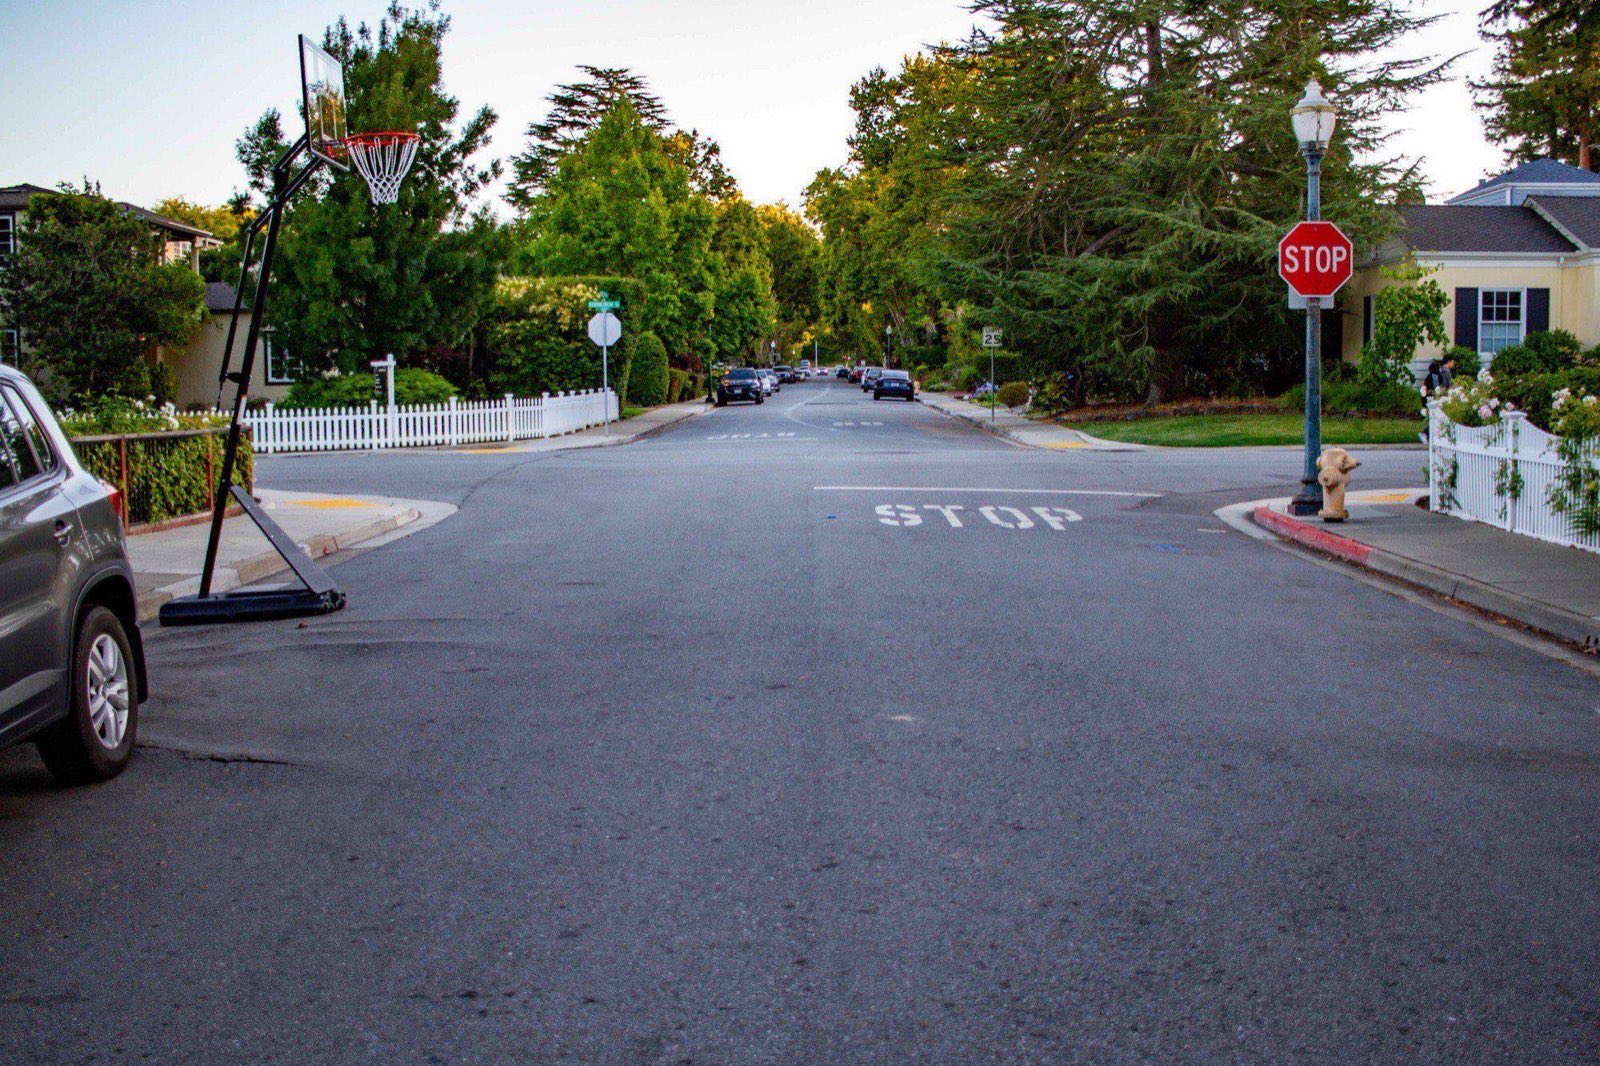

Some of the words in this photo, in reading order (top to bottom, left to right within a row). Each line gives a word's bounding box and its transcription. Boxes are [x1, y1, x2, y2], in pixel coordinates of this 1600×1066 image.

[1284, 245, 1347, 273] STOP
[984, 334, 1001, 345] 25
[874, 504, 1083, 531] STOP
